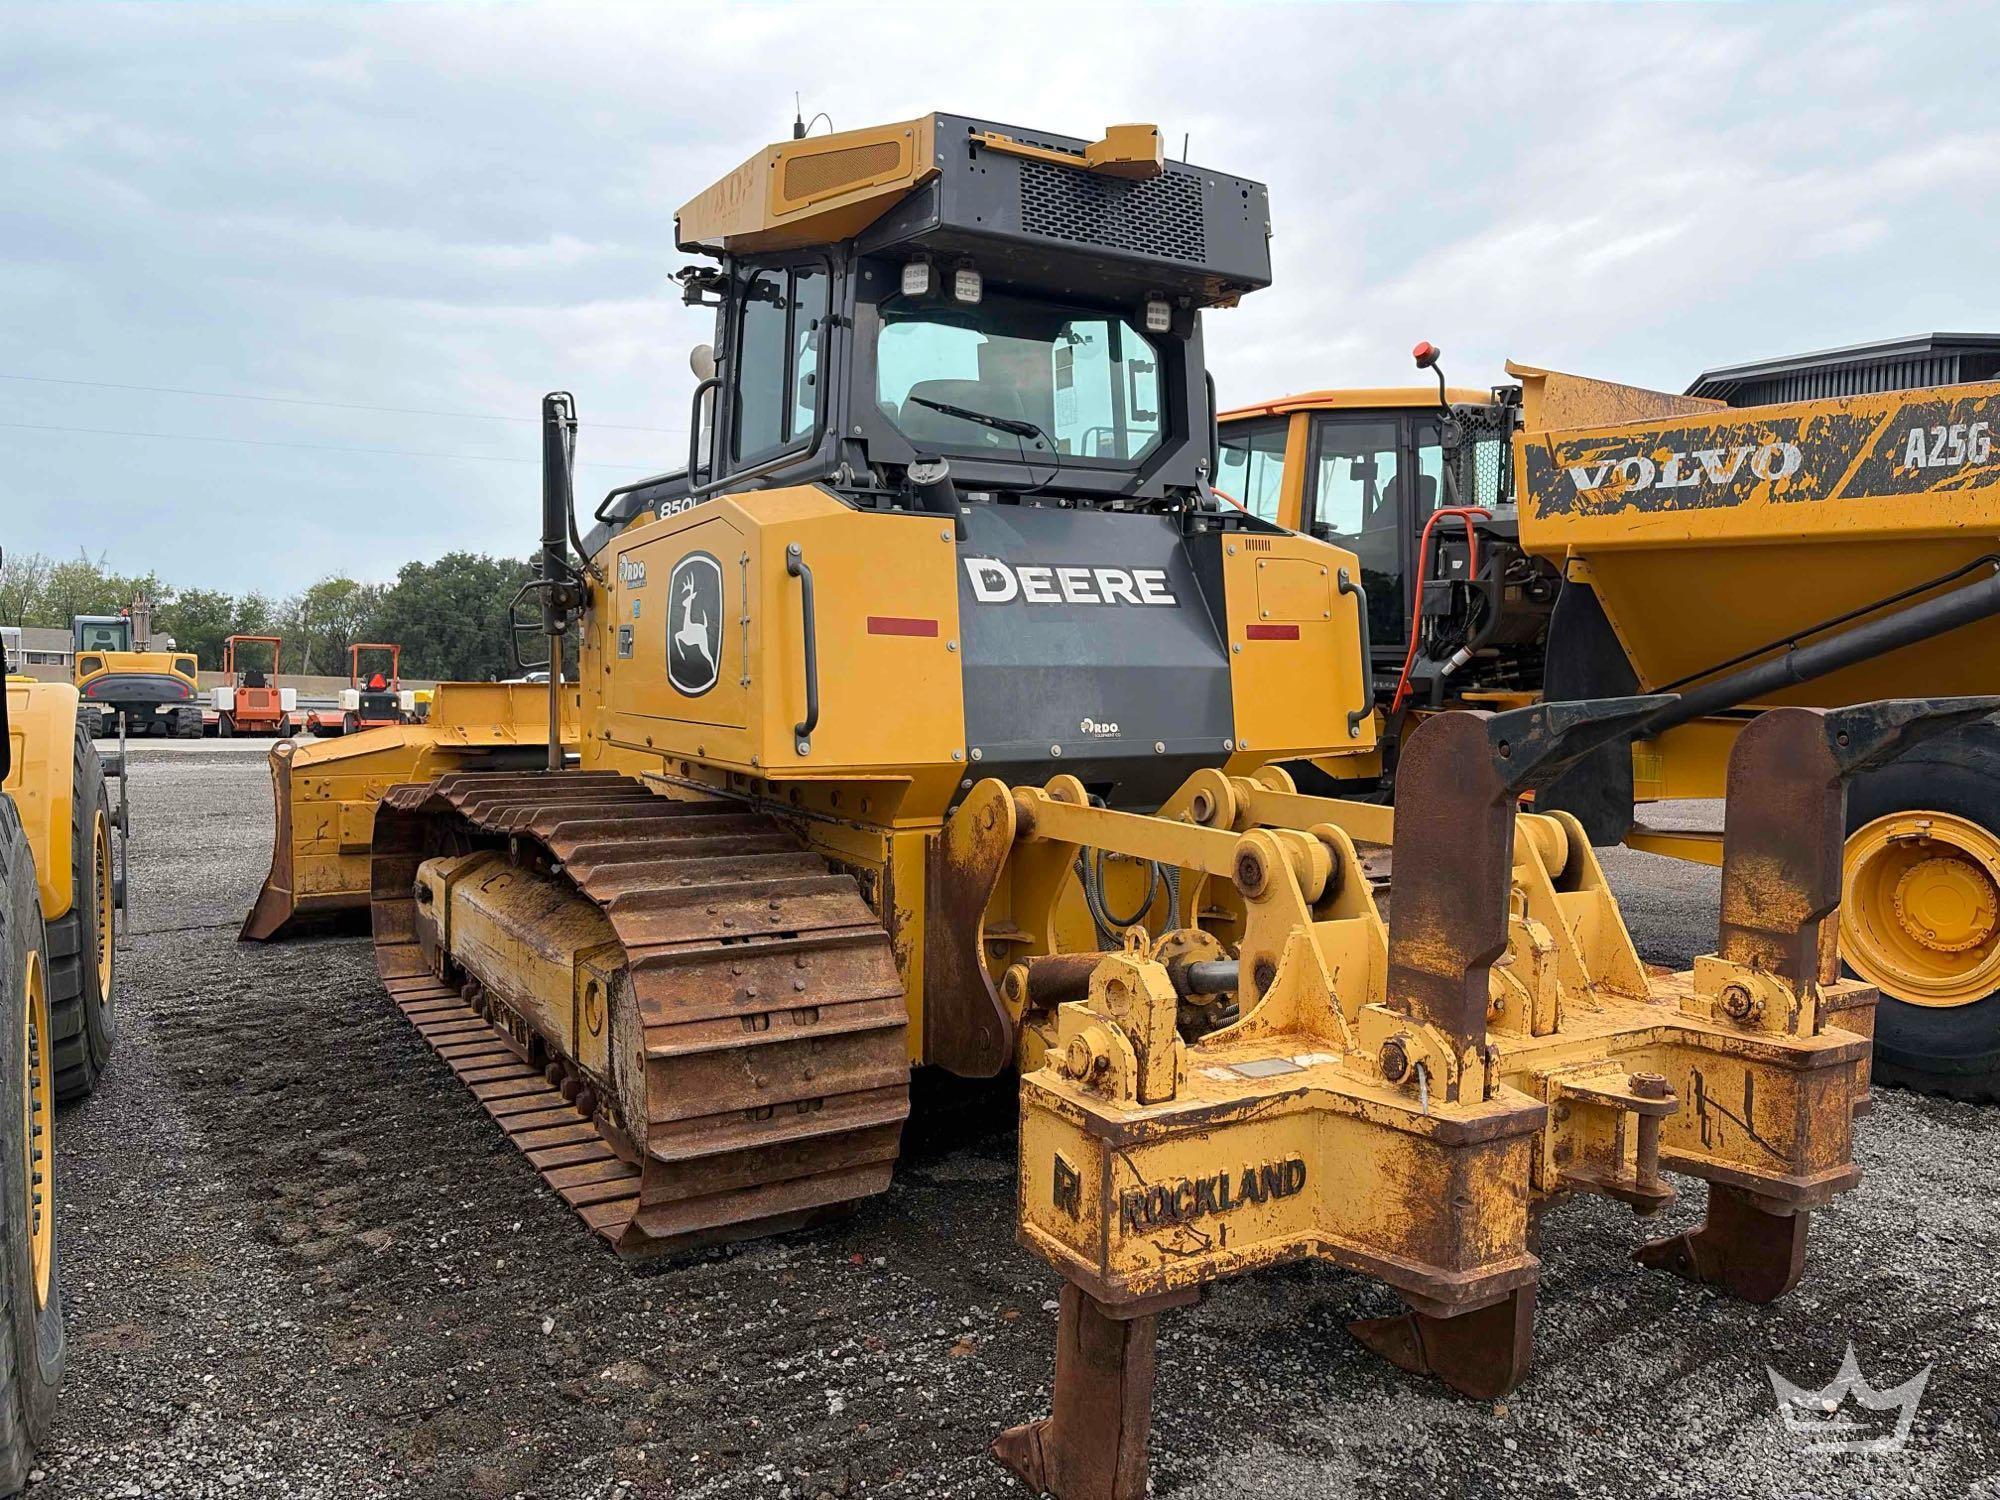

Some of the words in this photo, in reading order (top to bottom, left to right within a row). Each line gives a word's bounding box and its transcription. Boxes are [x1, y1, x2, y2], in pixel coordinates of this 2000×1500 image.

[1567, 442, 1801, 493] VOLVO
[1904, 421, 1991, 469] A25G
[964, 558, 1176, 604] DEERE
[1119, 1157, 1307, 1238] ROCKLAND
